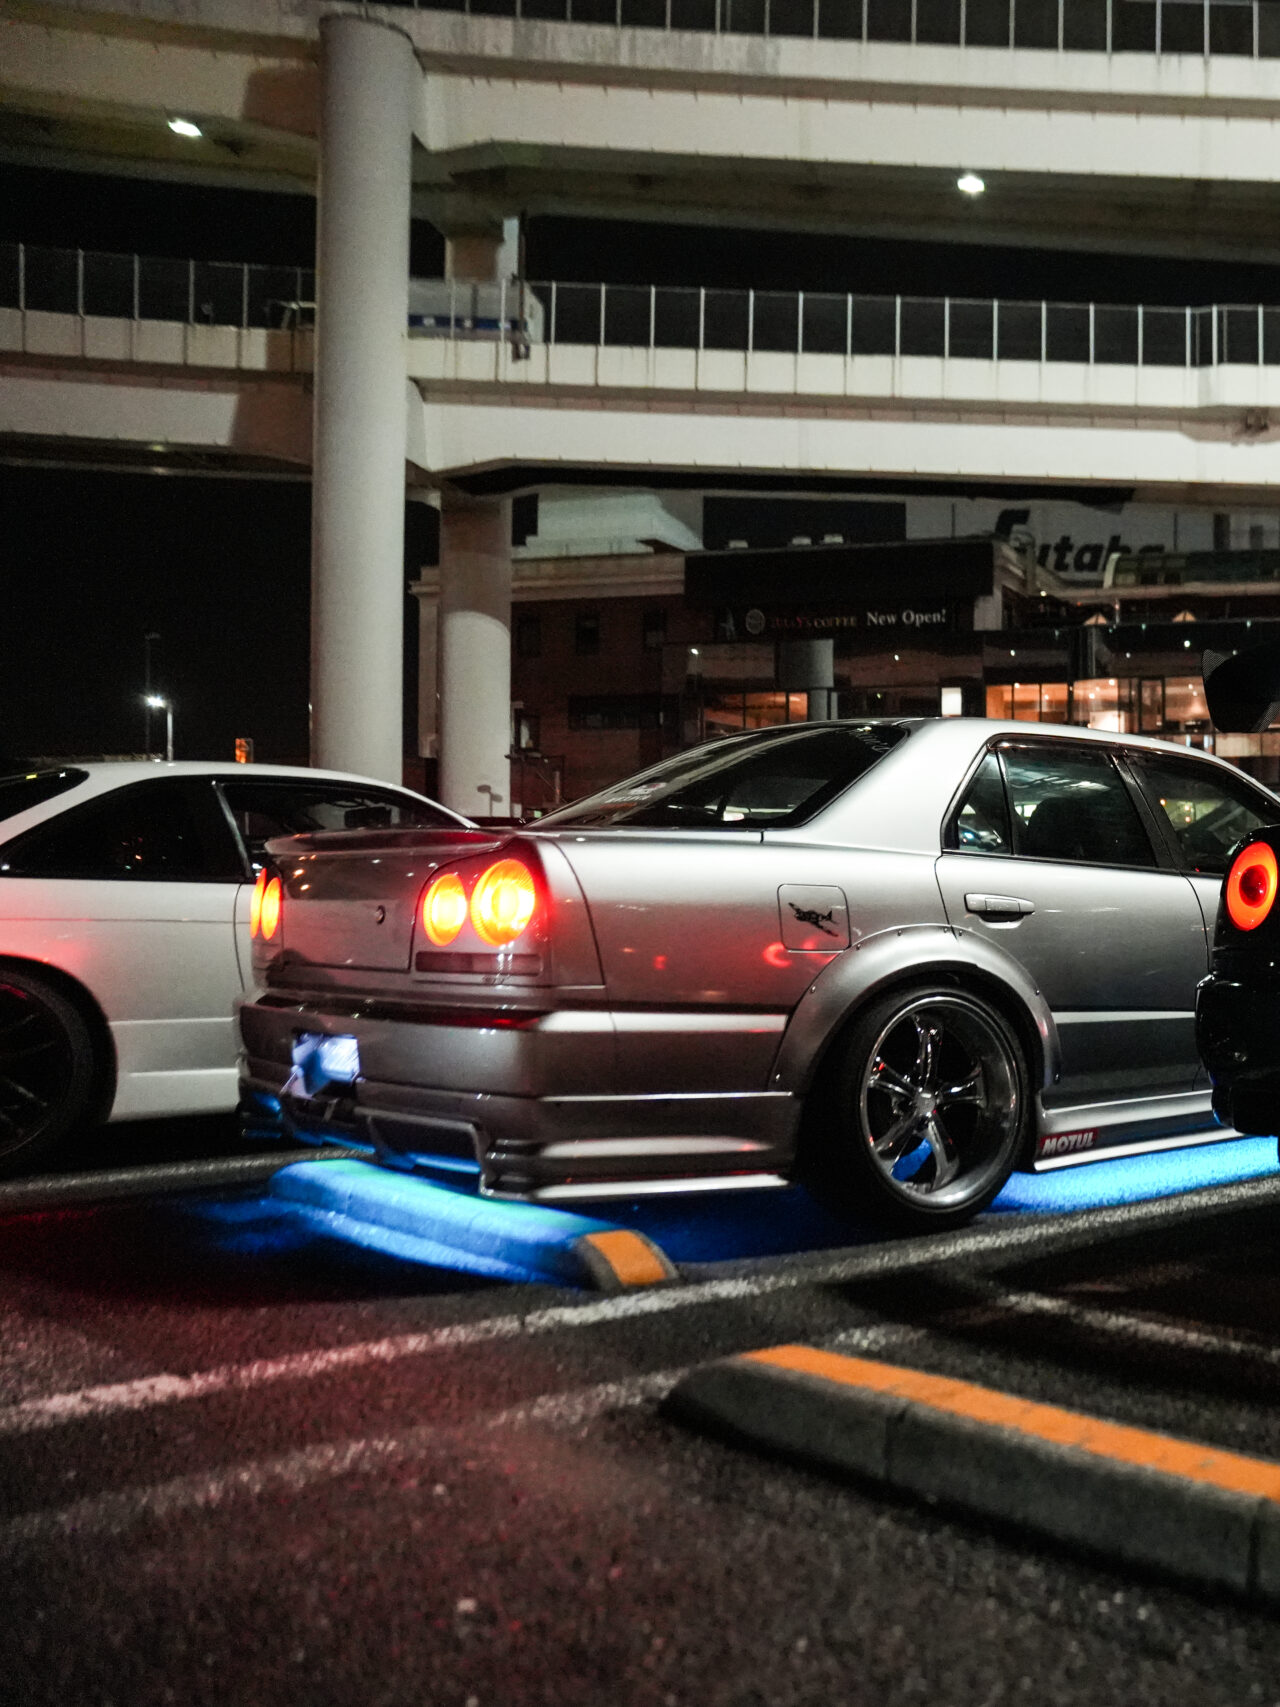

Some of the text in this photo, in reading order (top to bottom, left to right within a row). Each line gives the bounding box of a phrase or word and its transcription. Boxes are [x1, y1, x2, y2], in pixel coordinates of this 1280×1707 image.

[866, 611, 897, 627] New
[901, 608, 947, 628] Open!
[1041, 1132, 1094, 1155] MOTUL
